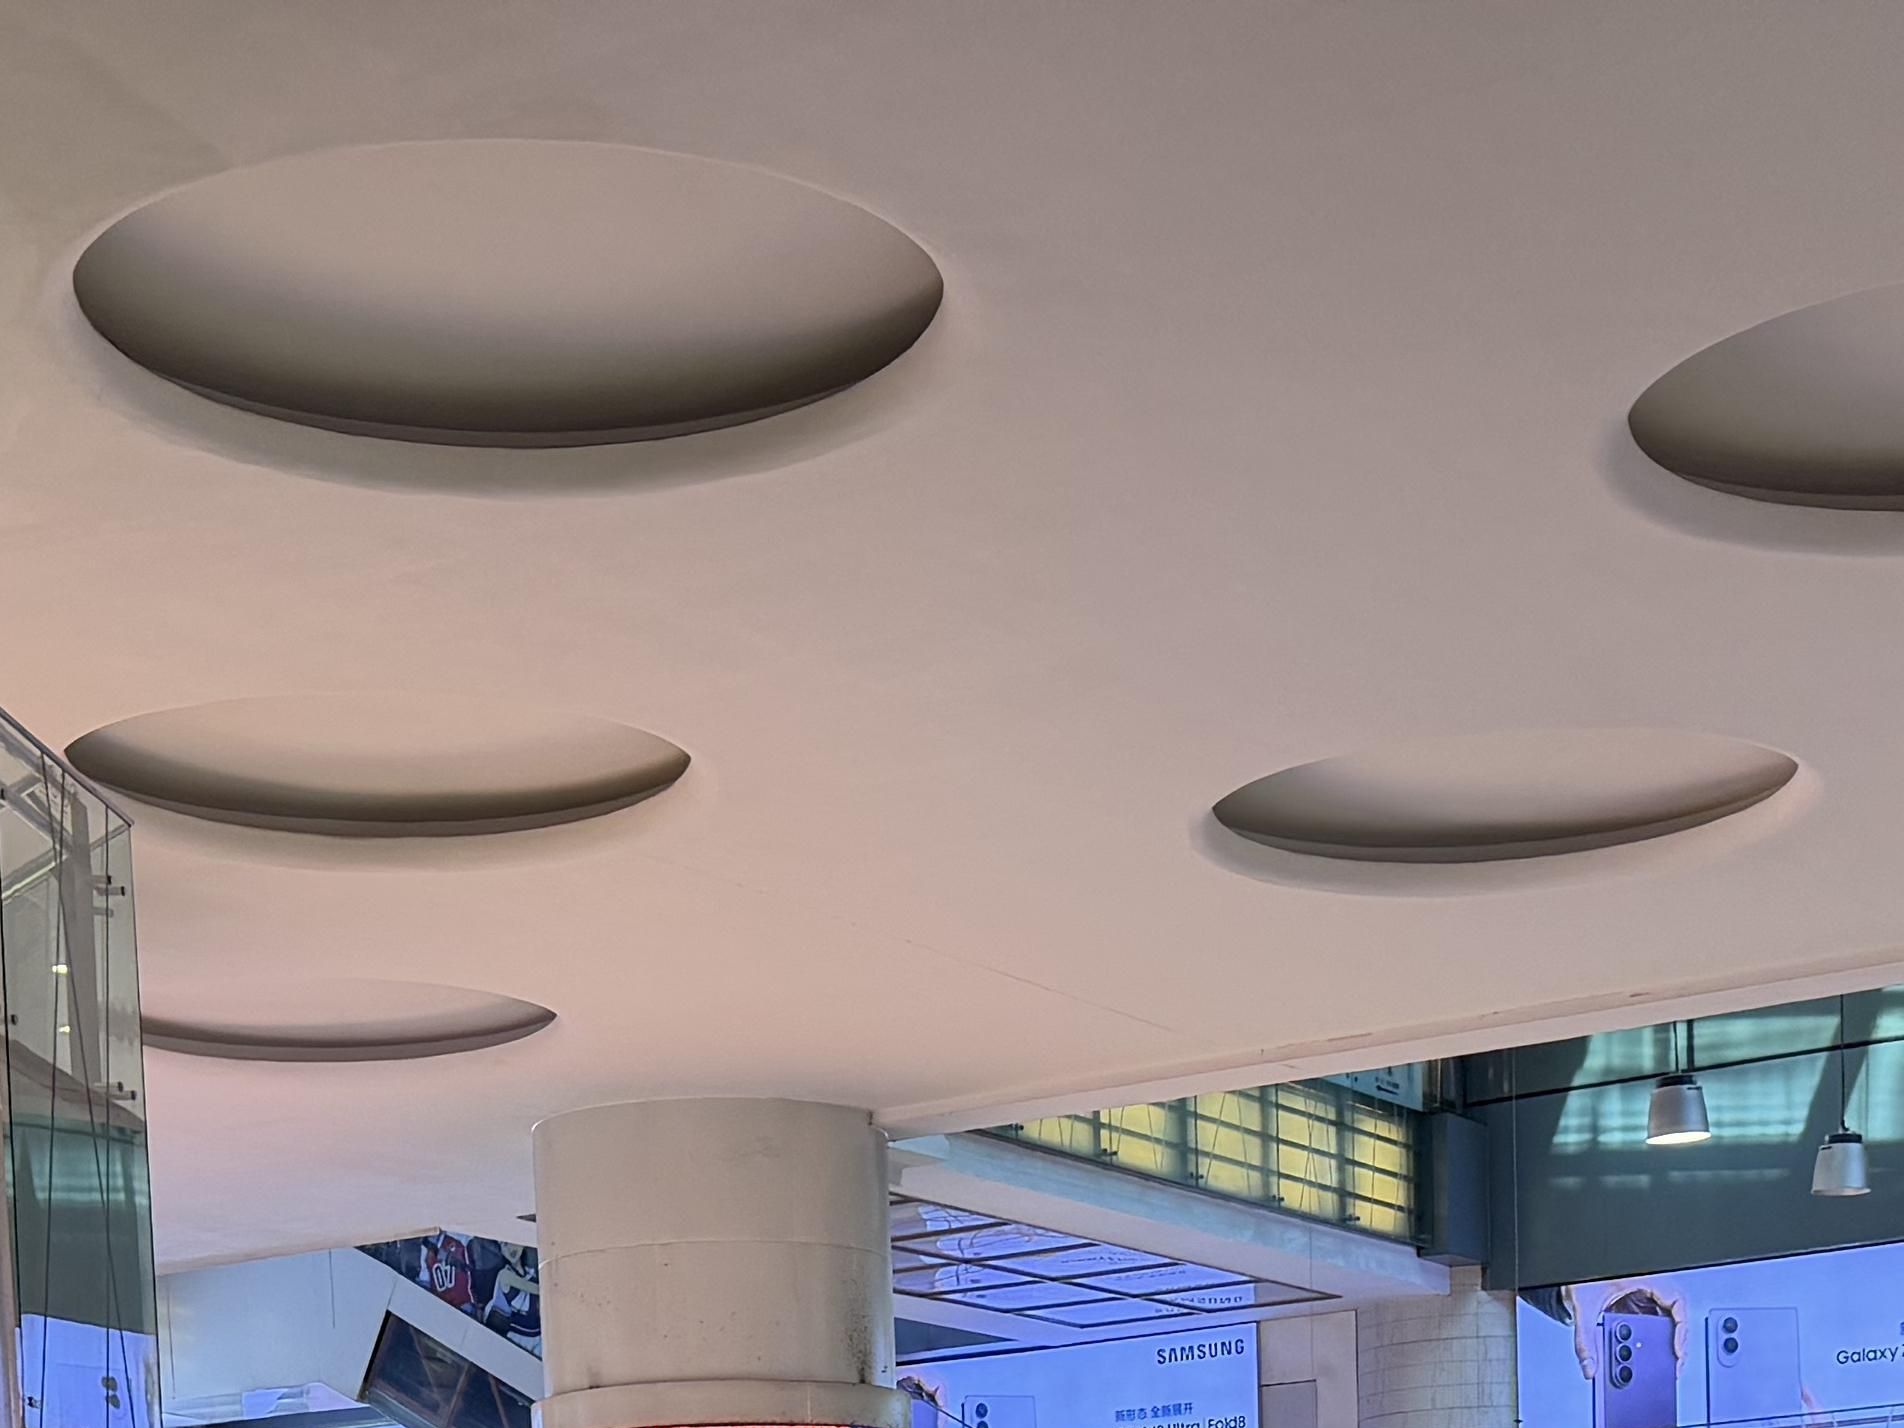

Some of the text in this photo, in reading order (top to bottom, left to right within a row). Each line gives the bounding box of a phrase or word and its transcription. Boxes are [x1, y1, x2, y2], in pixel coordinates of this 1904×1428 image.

[1156, 1338, 1245, 1365] SAMSUNG
[1836, 1345, 1899, 1365] Galaxy
[1114, 1402, 1194, 1422] 新形态 全新展开
